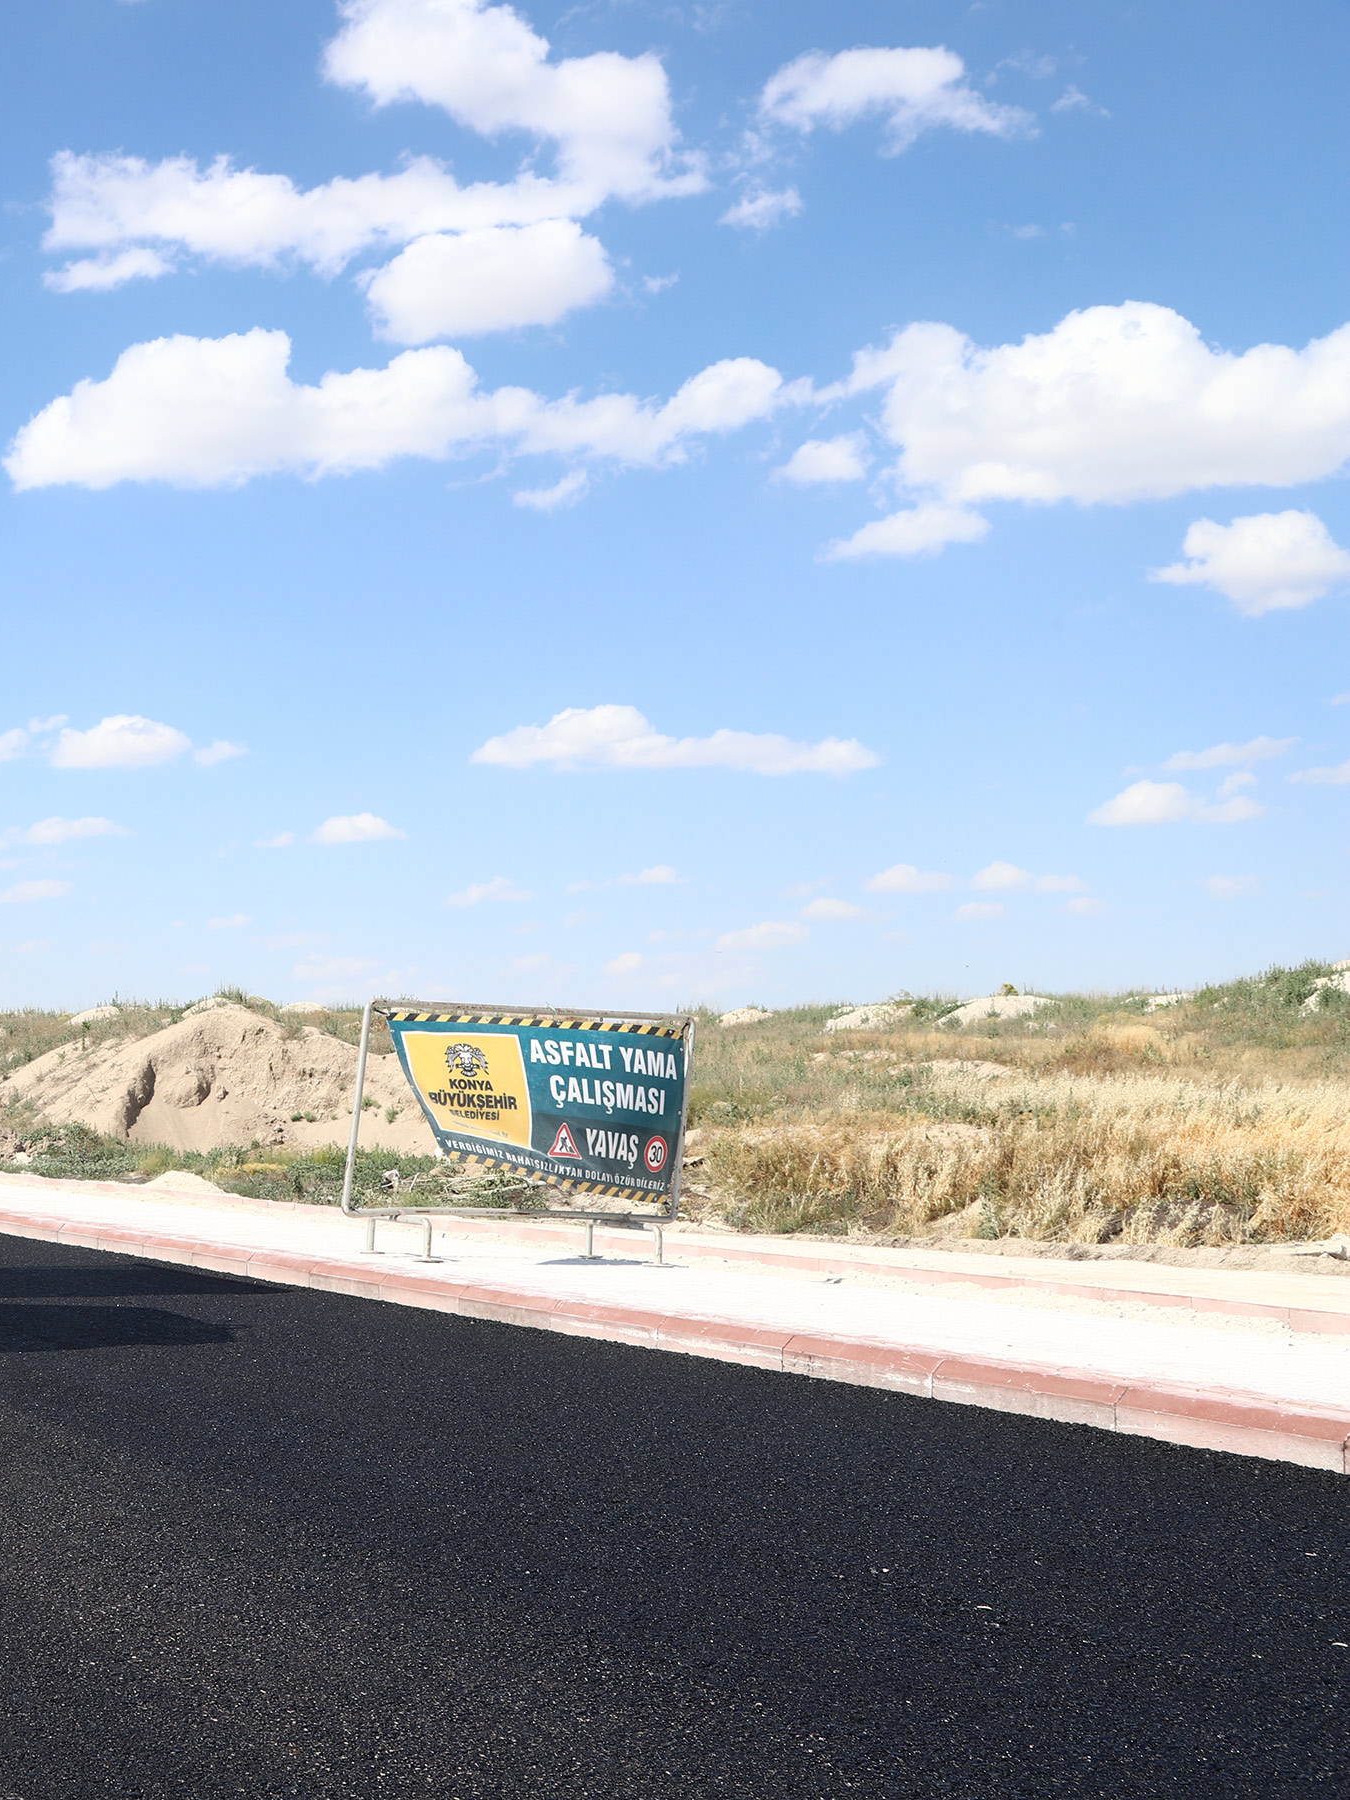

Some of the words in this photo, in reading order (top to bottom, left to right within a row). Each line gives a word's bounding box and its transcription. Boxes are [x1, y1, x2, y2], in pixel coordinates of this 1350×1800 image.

[530, 1039, 613, 1071] ASFALT
[618, 1046, 678, 1081] YAMA
[428, 1089, 518, 1110] BÜYÜKŞEHİR
[449, 1078, 494, 1092] KONYA
[549, 1075, 665, 1116] ÇALIŞMASI
[449, 1108, 500, 1121] BELEDİYESİ
[585, 1127, 639, 1170] YAVAŞ
[648, 1145, 664, 1164] 30
[444, 1138, 505, 1158] VERDİĞİMİZ
[505, 1152, 583, 1178] RAHATSIZLIKTAN
[585, 1170, 614, 1183] DOLAYI
[614, 1173, 636, 1187] ÖZÜR
[636, 1177, 665, 1192] DİLERİZ
